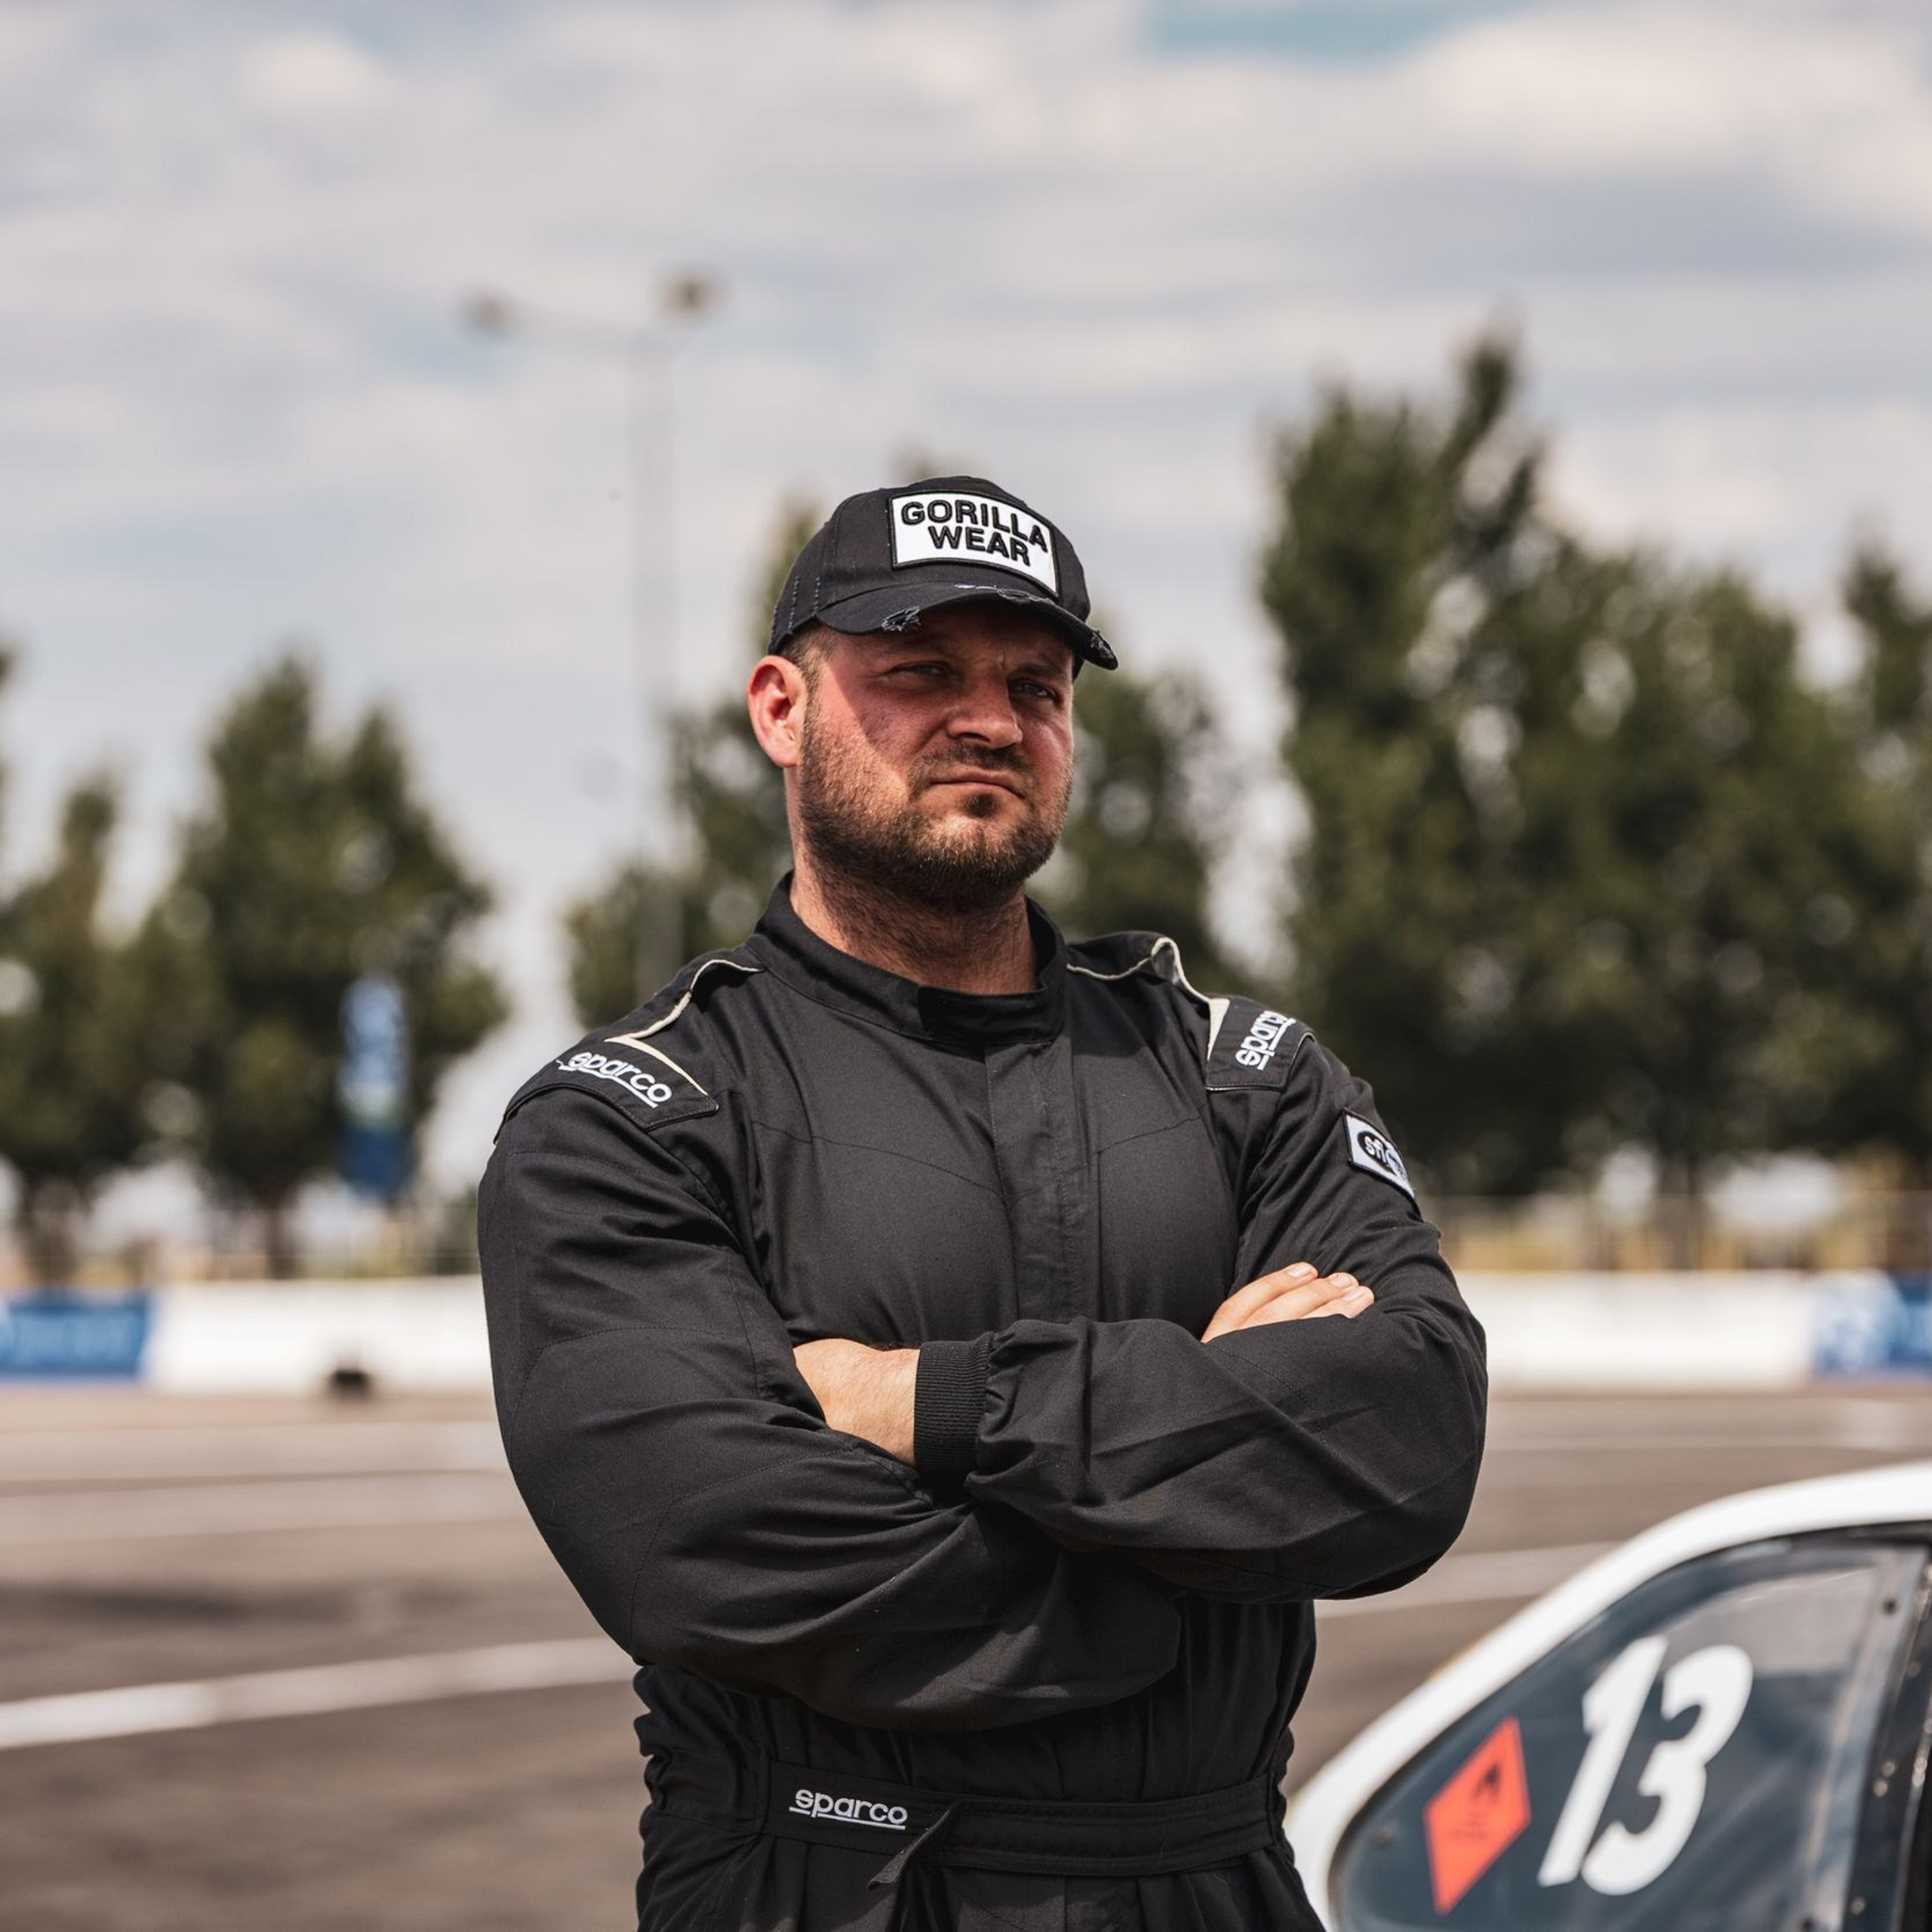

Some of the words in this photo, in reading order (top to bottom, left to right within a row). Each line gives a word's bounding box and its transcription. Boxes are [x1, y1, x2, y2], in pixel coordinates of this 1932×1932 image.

[901, 500, 1048, 552] GORILLA
[928, 526, 1030, 566] WEAR
[568, 1052, 672, 1103] sparco
[1537, 1636, 1754, 1896] 13
[795, 1789, 908, 1825] sparco
